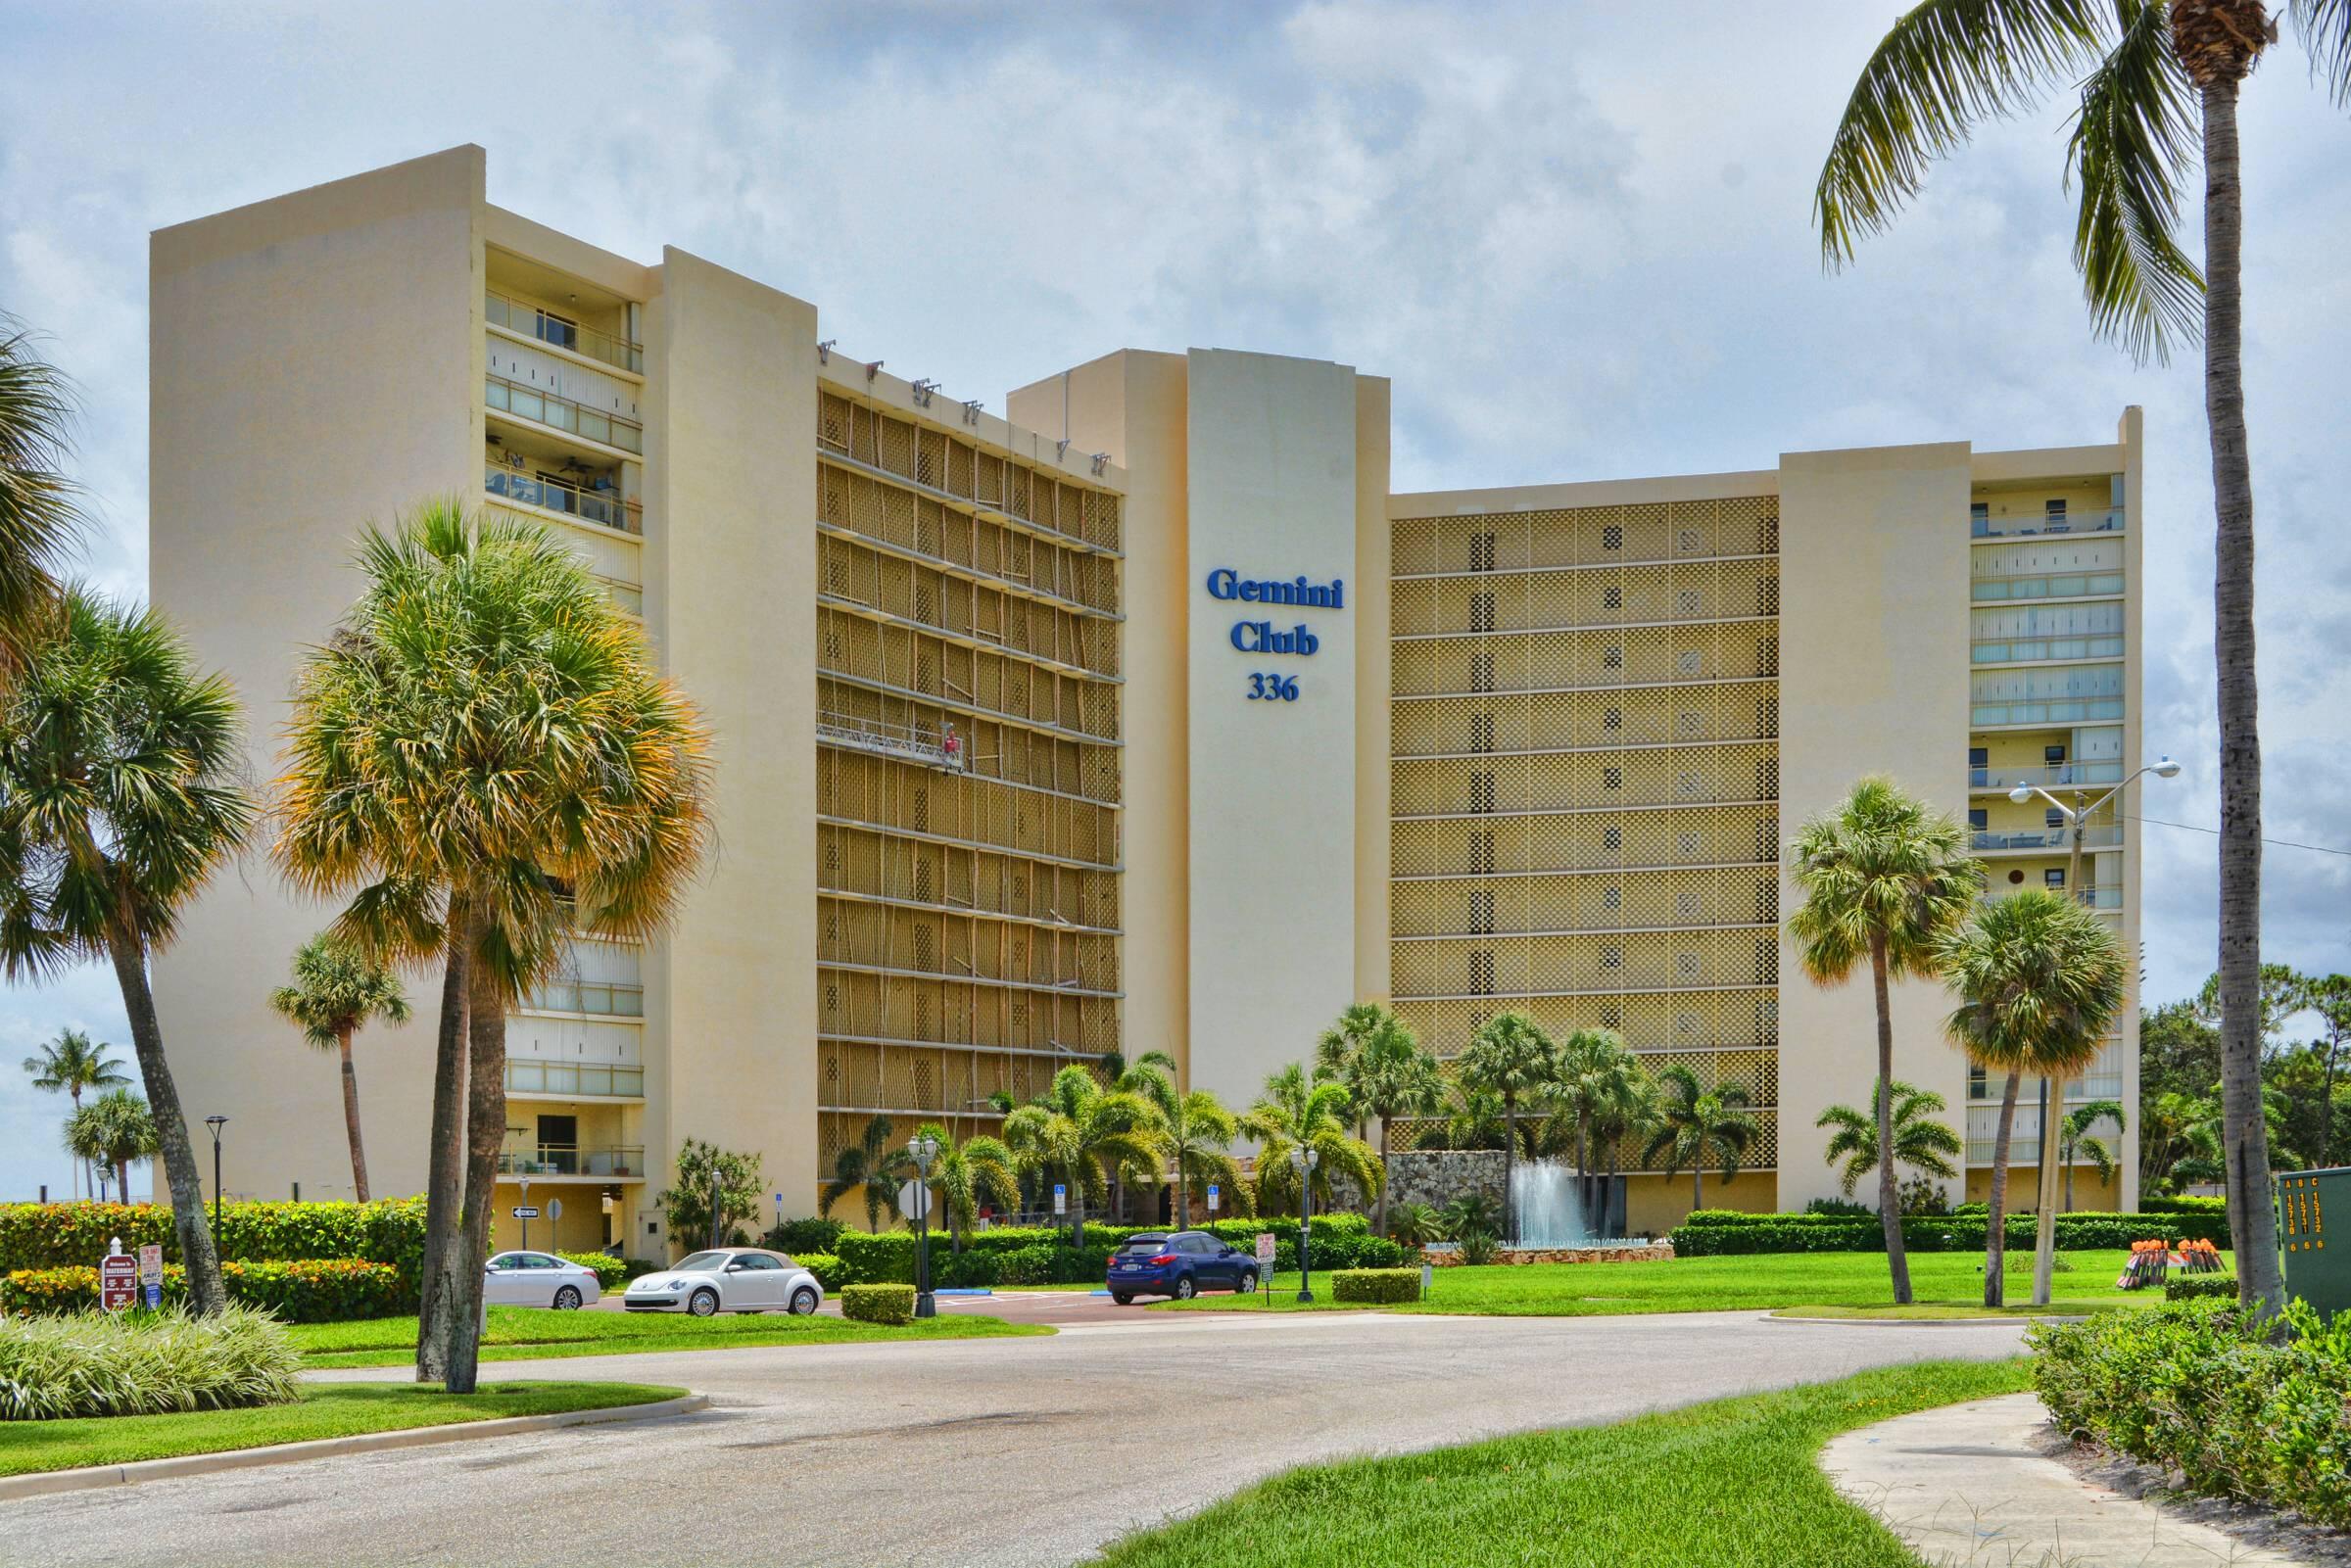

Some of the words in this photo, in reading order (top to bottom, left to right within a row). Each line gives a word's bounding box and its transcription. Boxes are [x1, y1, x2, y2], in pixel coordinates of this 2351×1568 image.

[1207, 568, 1344, 609] Gemini
[1230, 620, 1319, 656] Club
[1247, 672, 1300, 702] 336
[2284, 1179, 2292, 1189] A
[2311, 1177, 2319, 1186] C
[2313, 1191, 2322, 1233] 15732
[2290, 1244, 2297, 1253] 6
[2317, 1240, 2324, 1249] 6
